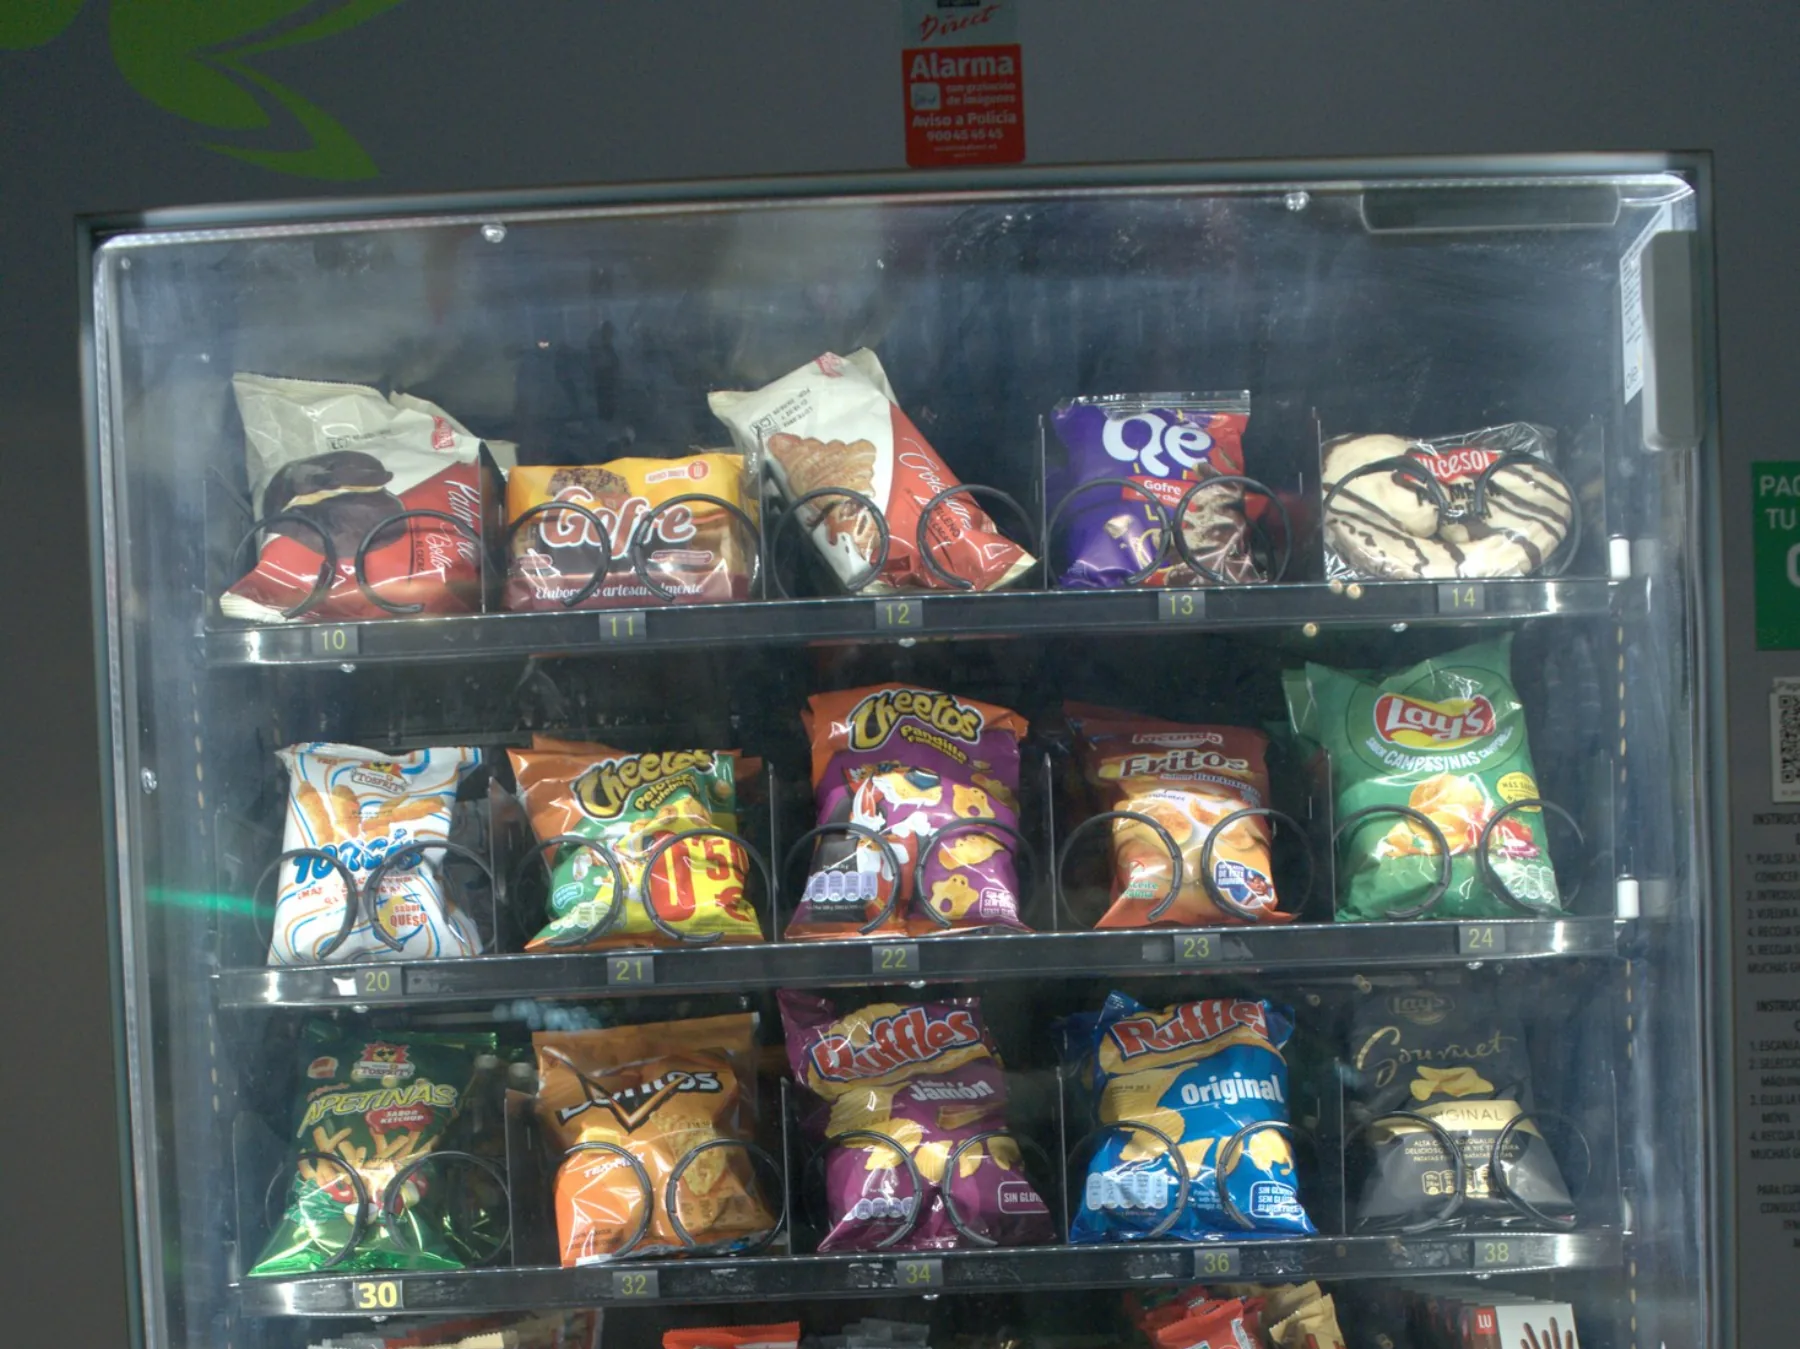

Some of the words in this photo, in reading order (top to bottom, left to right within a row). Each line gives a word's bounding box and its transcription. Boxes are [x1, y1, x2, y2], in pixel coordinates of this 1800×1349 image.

[910, 52, 1014, 79] Alarma
[913, 113, 952, 128] Aviso
[956, 115, 964, 125] a
[968, 110, 1016, 125] Policía
[1415, 450, 1496, 478] ulcesol
[1143, 479, 1182, 496] Gofre
[1765, 508, 1796, 530] TU
[1169, 596, 1194, 615] 13
[1452, 589, 1476, 607] 14
[885, 604, 910, 624] 12
[609, 617, 634, 637] 11
[321, 629, 346, 650] 10
[850, 689, 982, 751] Cheetos
[1385, 697, 1486, 740] Lay's
[1121, 750, 1250, 777] Fritos
[390, 912, 427, 926] QUESO
[1184, 938, 1209, 957] 23
[1468, 929, 1493, 947] 24
[881, 950, 907, 968] 22
[616, 961, 643, 980] 21
[365, 972, 390, 991] 20
[811, 1005, 983, 1082] Ruffles
[1357, 1026, 1518, 1087] Gourmet
[909, 1079, 995, 1101] Jamón
[1181, 1071, 1285, 1105] Original
[1428, 1108, 1504, 1122] IGINAL
[1003, 1192, 1018, 1204] SIN
[1020, 1191, 1043, 1204] GLUT
[1484, 1242, 1510, 1262] 38
[1204, 1253, 1230, 1273] 36
[906, 1265, 931, 1283] 34
[358, 1281, 398, 1308] 30
[622, 1274, 647, 1295] 32
[1478, 1314, 1492, 1329] LU
